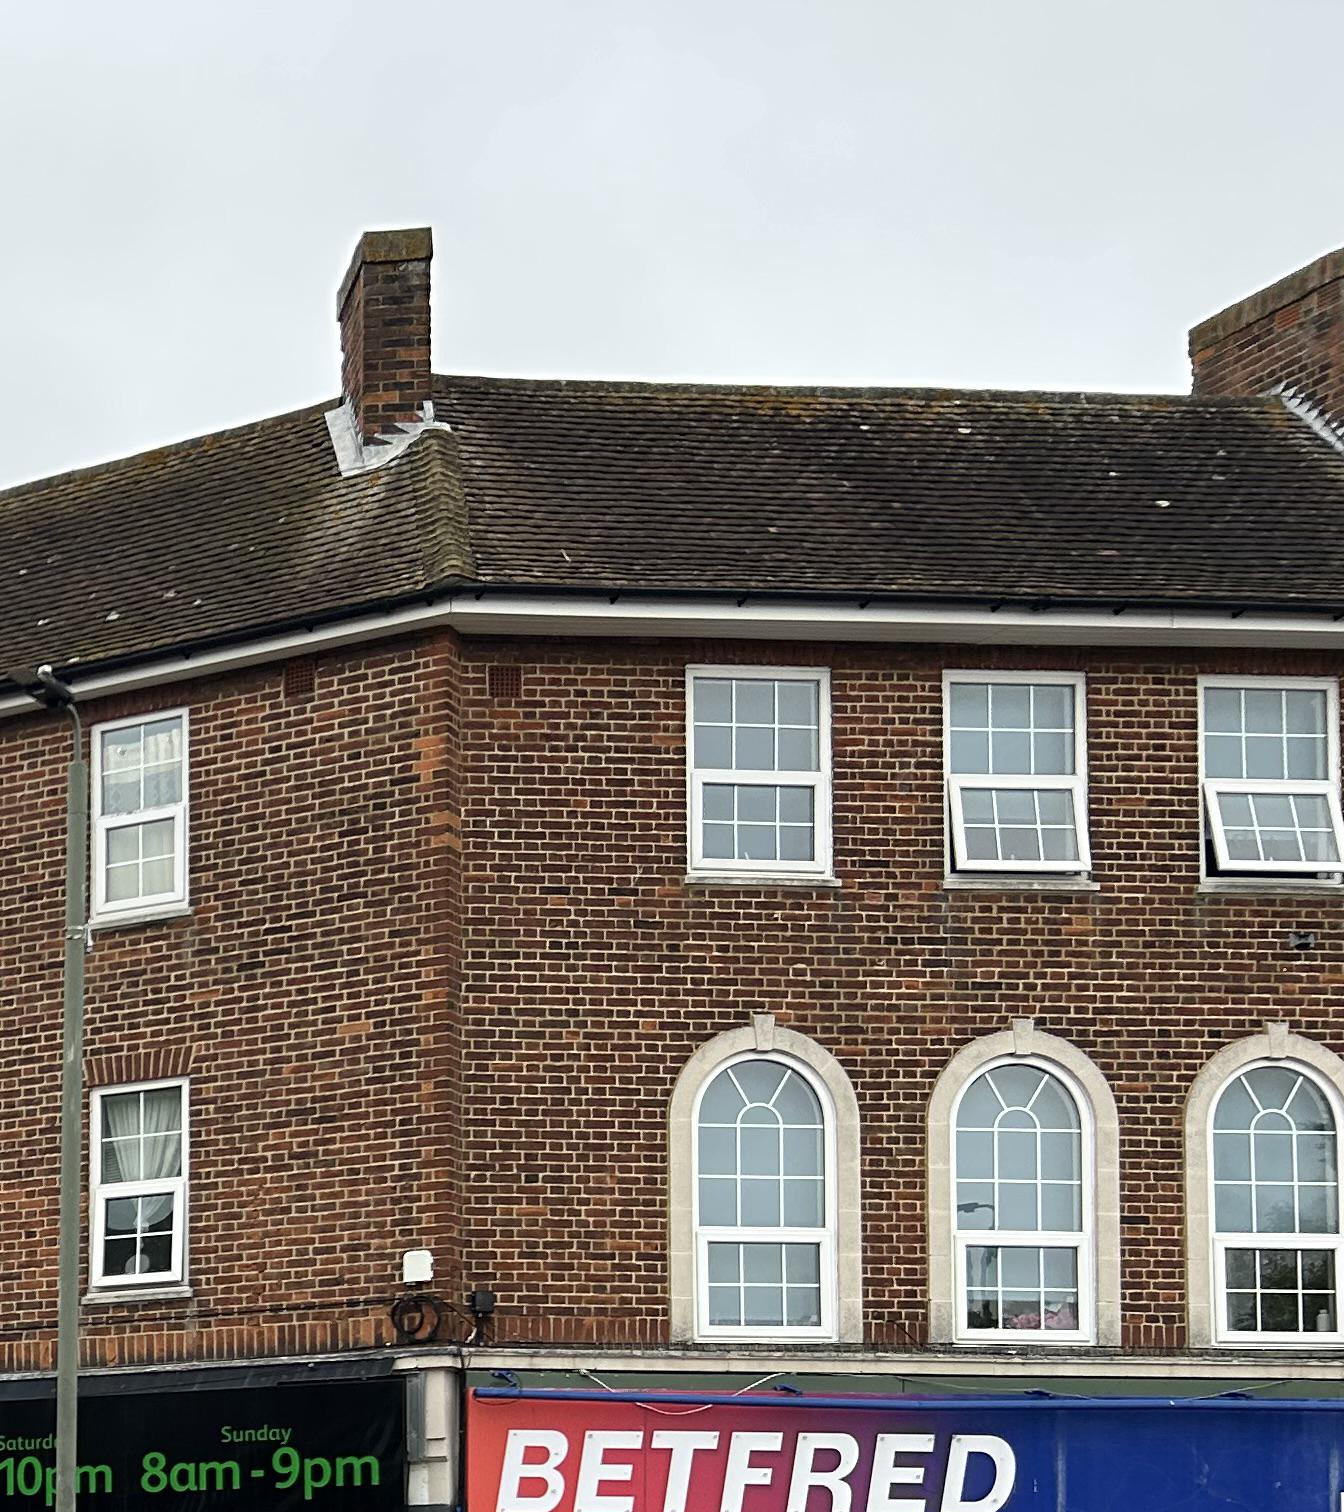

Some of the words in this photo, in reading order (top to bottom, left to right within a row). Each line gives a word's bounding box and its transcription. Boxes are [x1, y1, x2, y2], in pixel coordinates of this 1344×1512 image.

[221, 1425, 292, 1445] Sunday
[141, 1452, 241, 1494] 8am
[272, 1447, 380, 1500] 9pm
